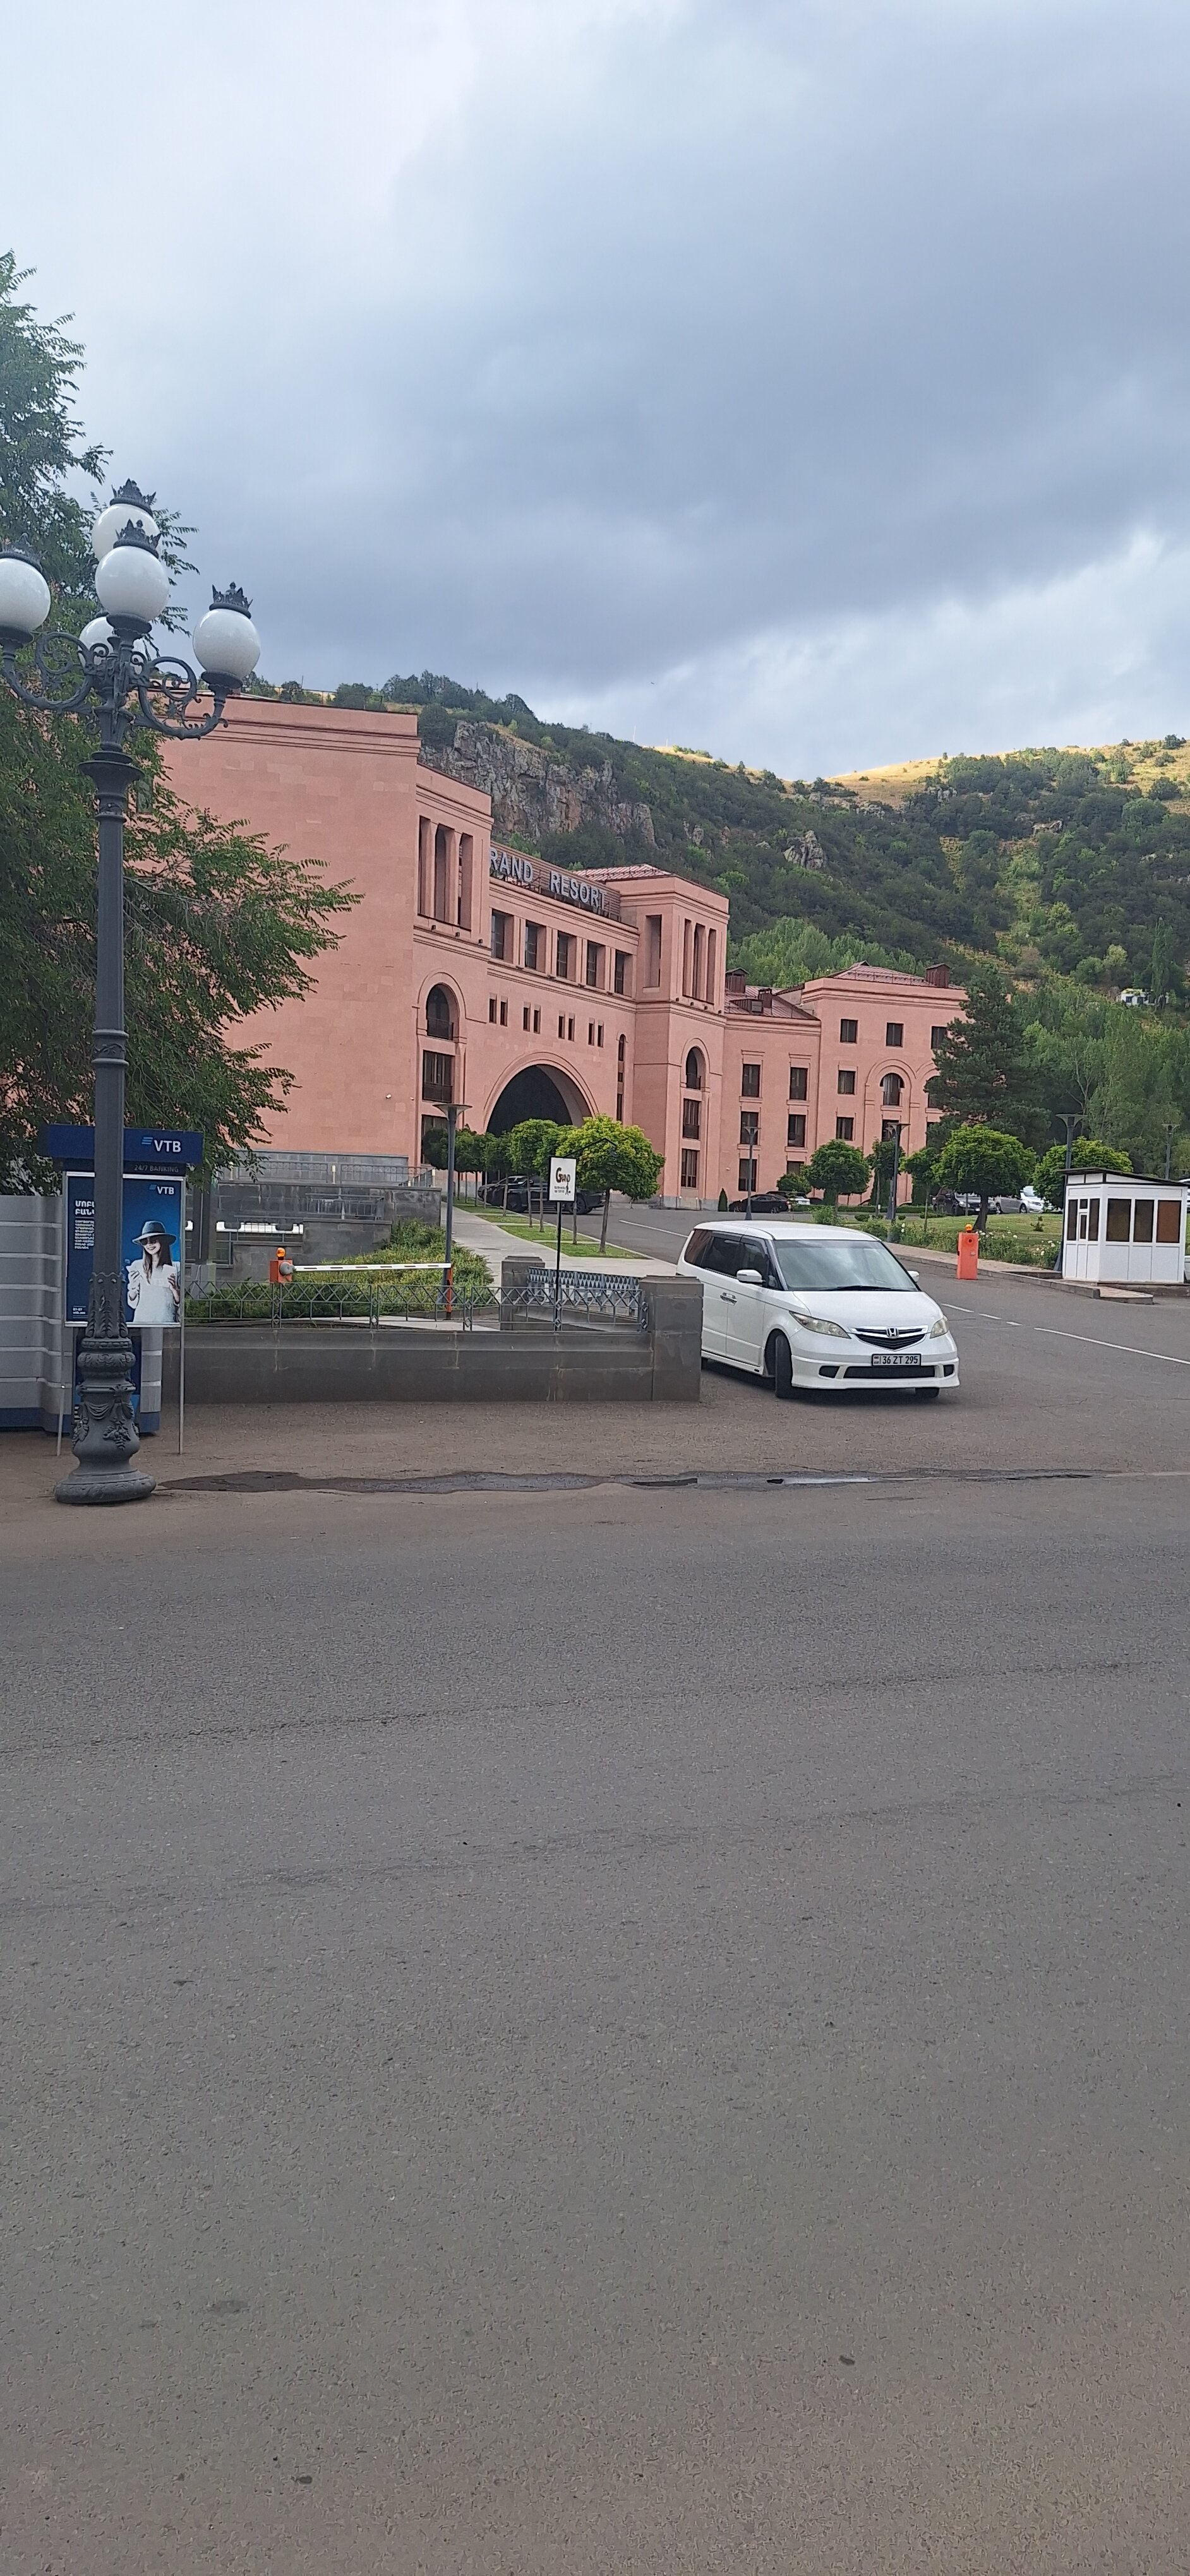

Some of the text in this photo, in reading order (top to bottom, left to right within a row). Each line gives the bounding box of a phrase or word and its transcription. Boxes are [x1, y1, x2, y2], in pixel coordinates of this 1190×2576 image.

[549, 871, 607, 910] RESORT
[154, 1140, 181, 1152] VTB
[157, 1186, 174, 1195] VTB
[882, 1356, 918, 1364] 36 ZT 295
